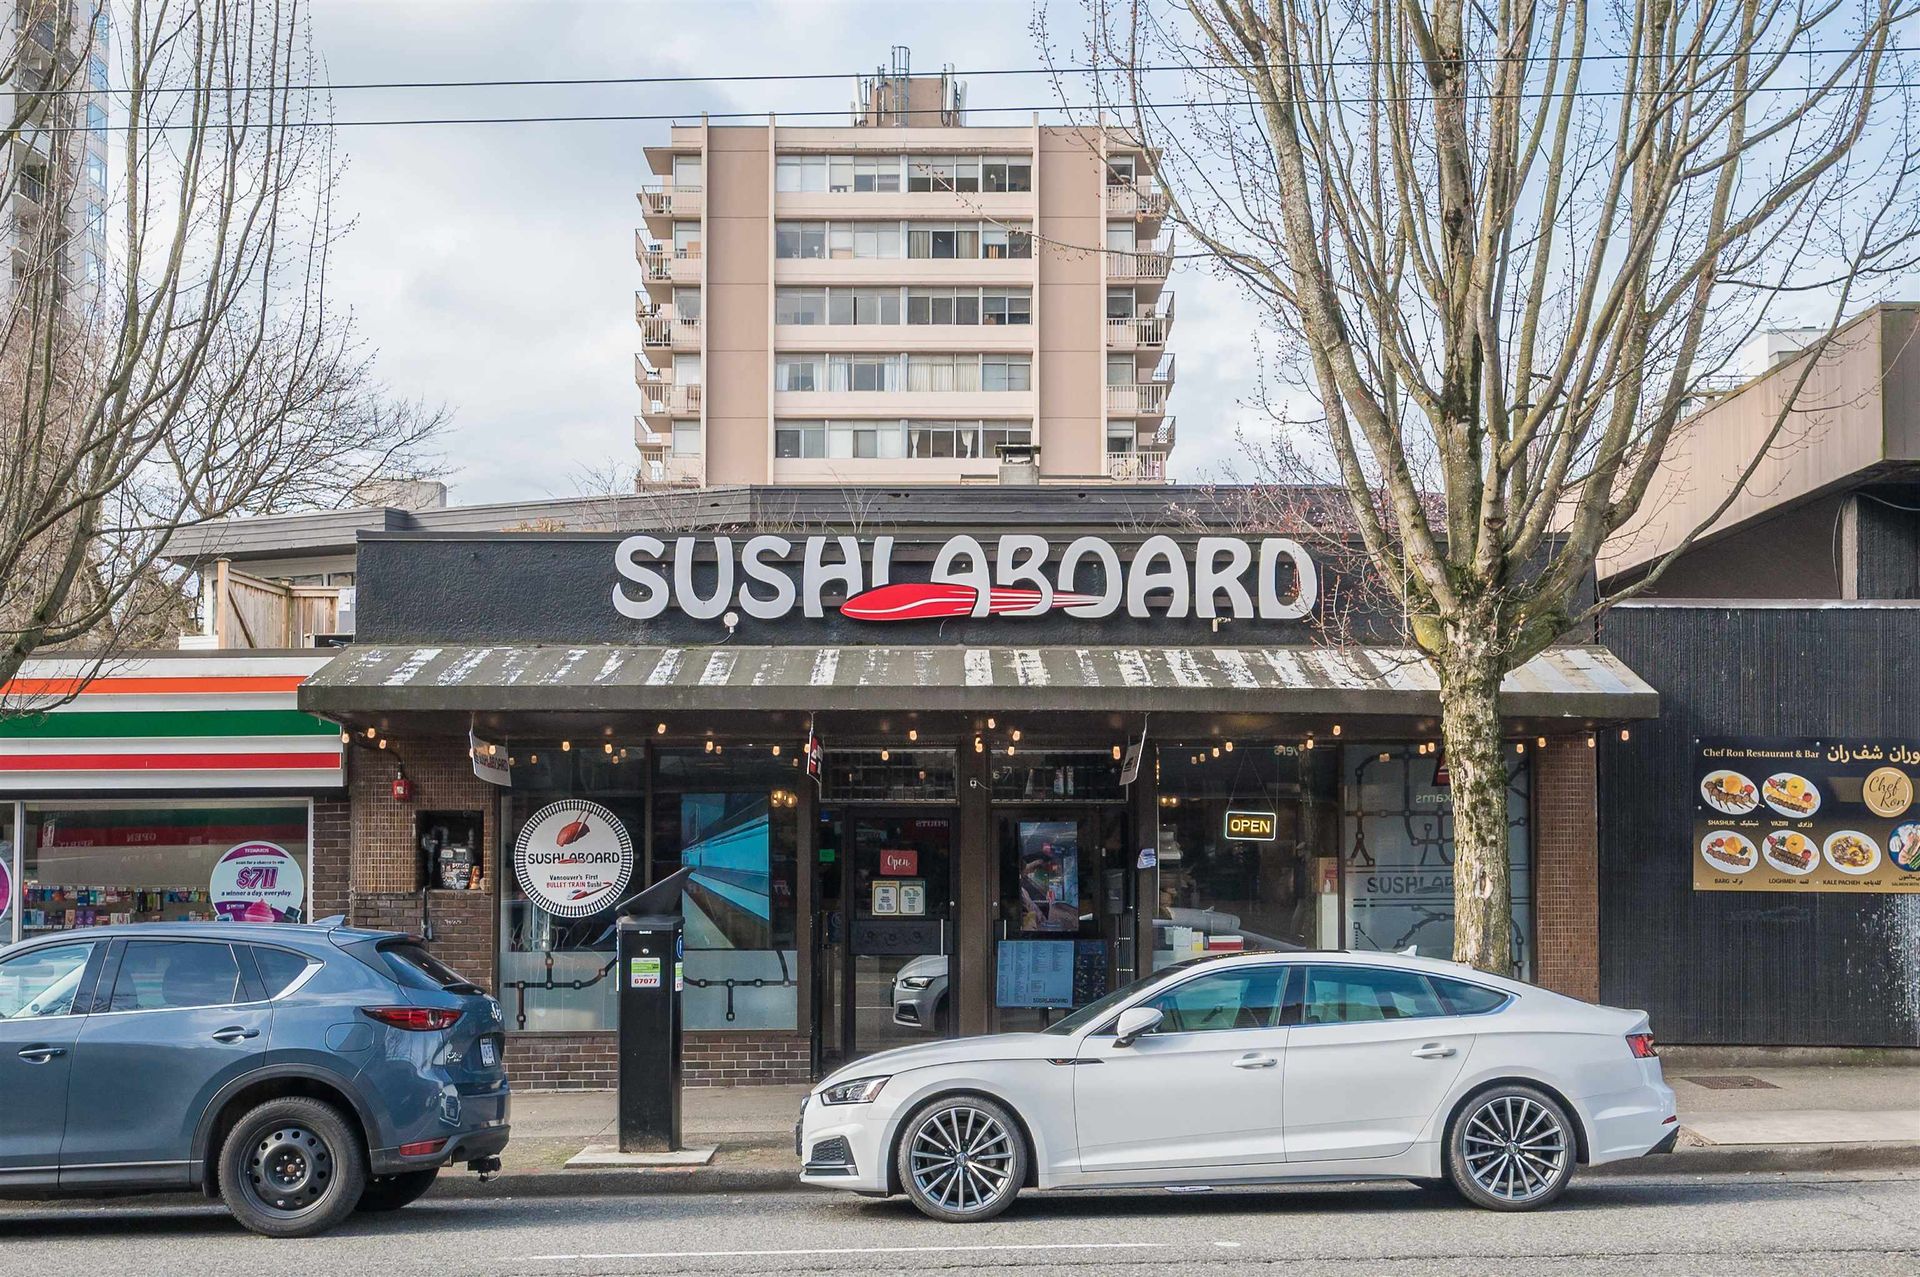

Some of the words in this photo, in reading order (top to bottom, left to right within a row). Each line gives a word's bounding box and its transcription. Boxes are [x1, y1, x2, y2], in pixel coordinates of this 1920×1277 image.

[612, 534, 895, 619] SUSHI
[930, 534, 1318, 619] ABOARD
[1703, 748, 1725, 757] Chef
[1726, 749, 1744, 757] Ron
[1746, 749, 1793, 758] Restaurant
[1795, 750, 1802, 758] &
[1804, 750, 1820, 758] Bar
[1827, 745, 1850, 763] ران
[1852, 744, 1883, 760] شف
[1868, 776, 1902, 799] Chef
[1880, 791, 1905, 808] Ron
[1231, 819, 1271, 833] OPEN
[528, 852, 565, 864] SUSHI
[568, 852, 620, 864] ABOARD
[887, 855, 911, 870] Open
[236, 867, 279, 890] $711
[1367, 876, 1424, 894] SUSHI
